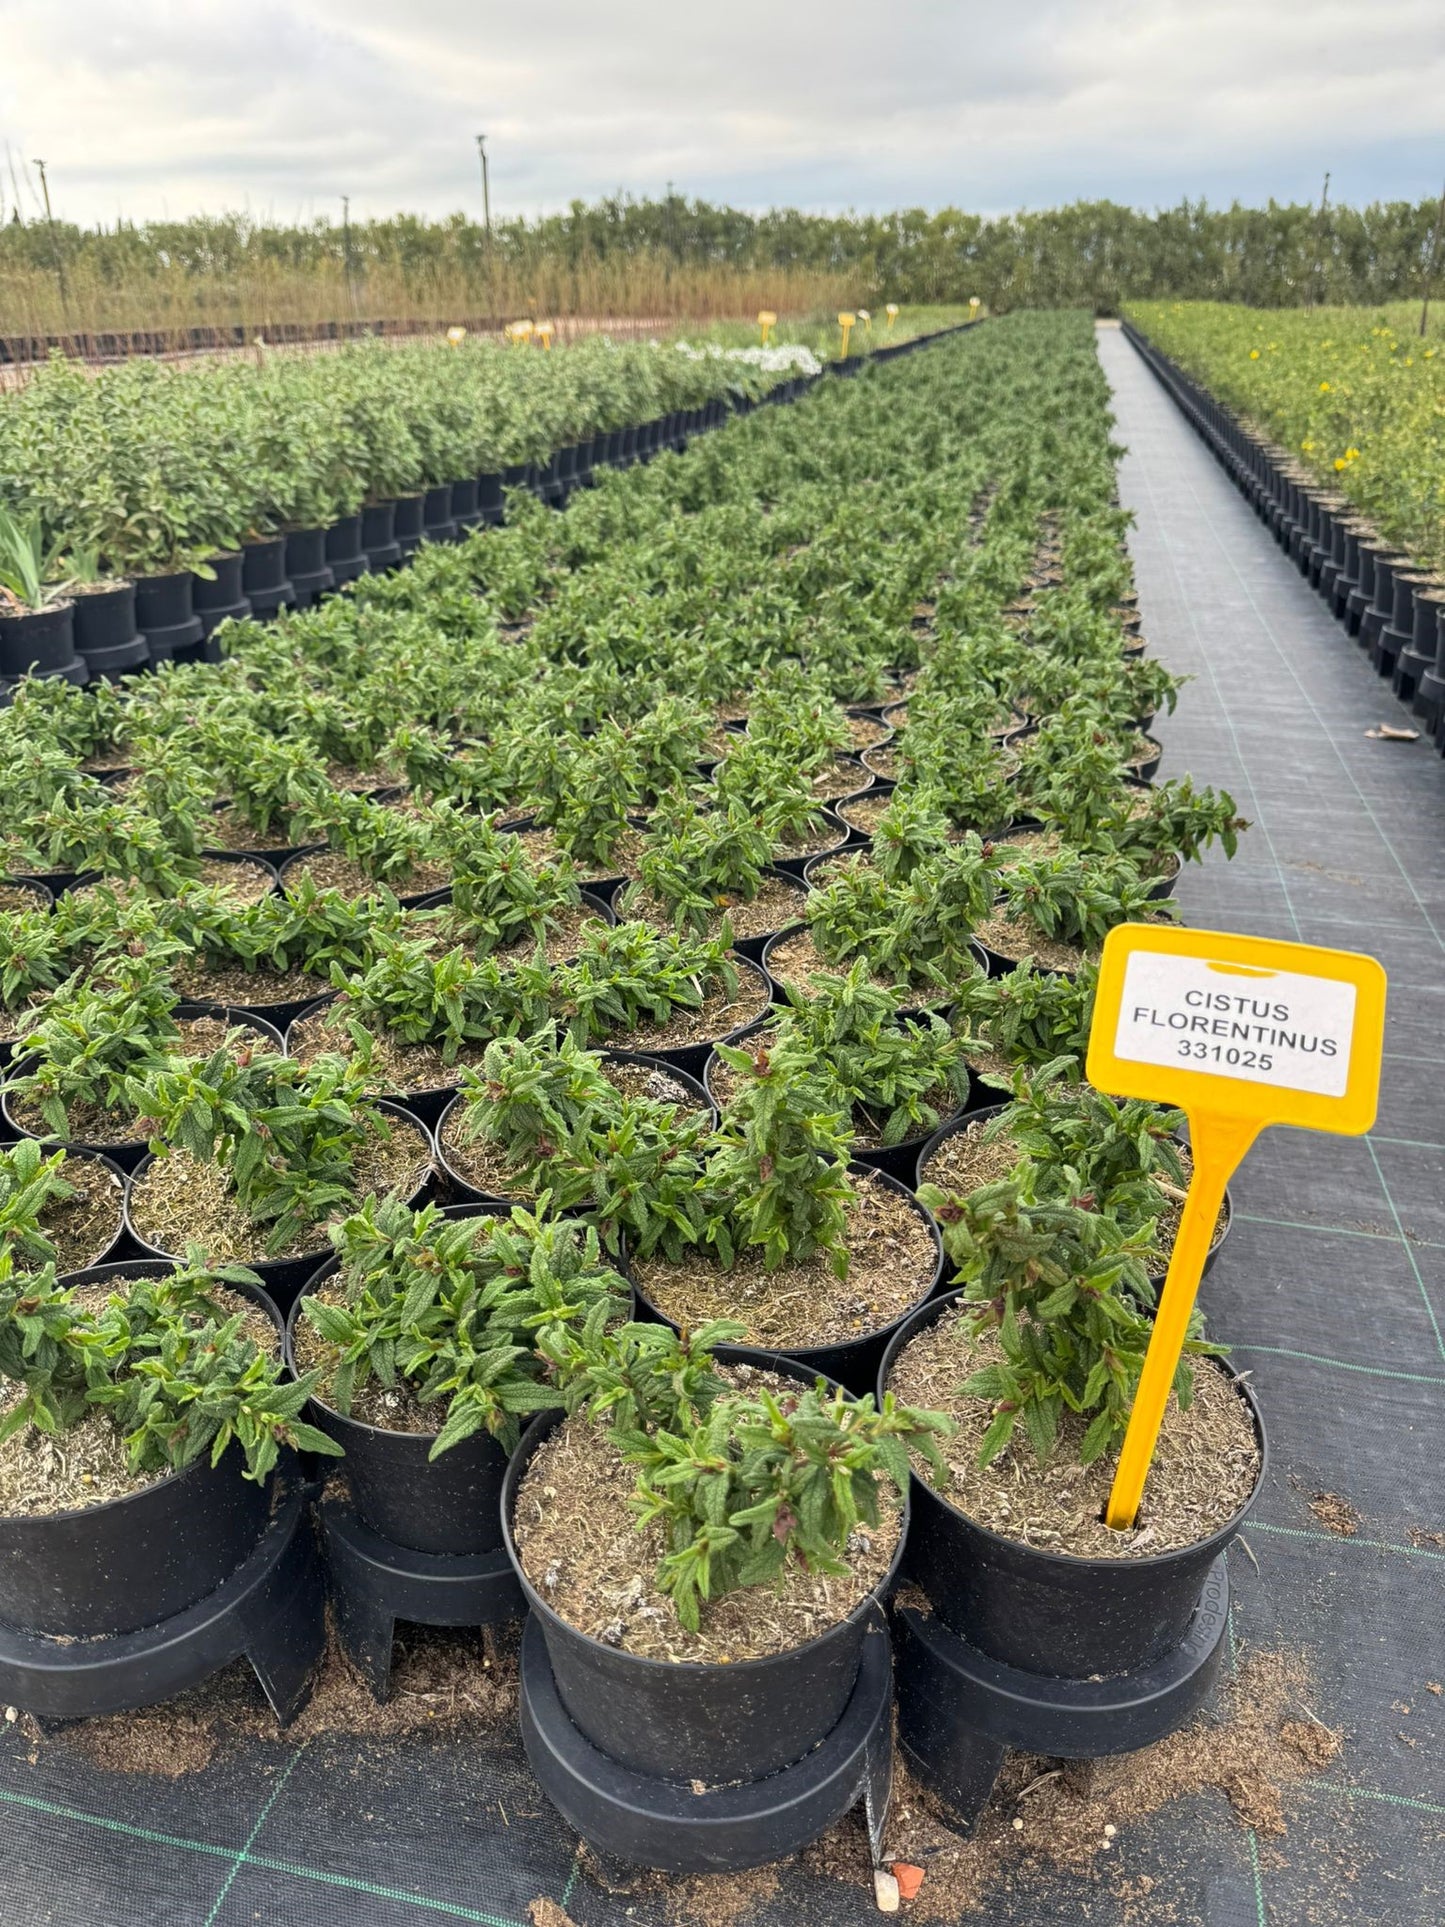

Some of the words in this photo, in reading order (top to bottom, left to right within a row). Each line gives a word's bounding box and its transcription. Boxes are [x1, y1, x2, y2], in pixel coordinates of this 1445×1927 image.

[1185, 990, 1290, 1021] CISTUS
[1133, 1007, 1337, 1056] FLORENTINUS
[1177, 1039, 1273, 1070] 331025
